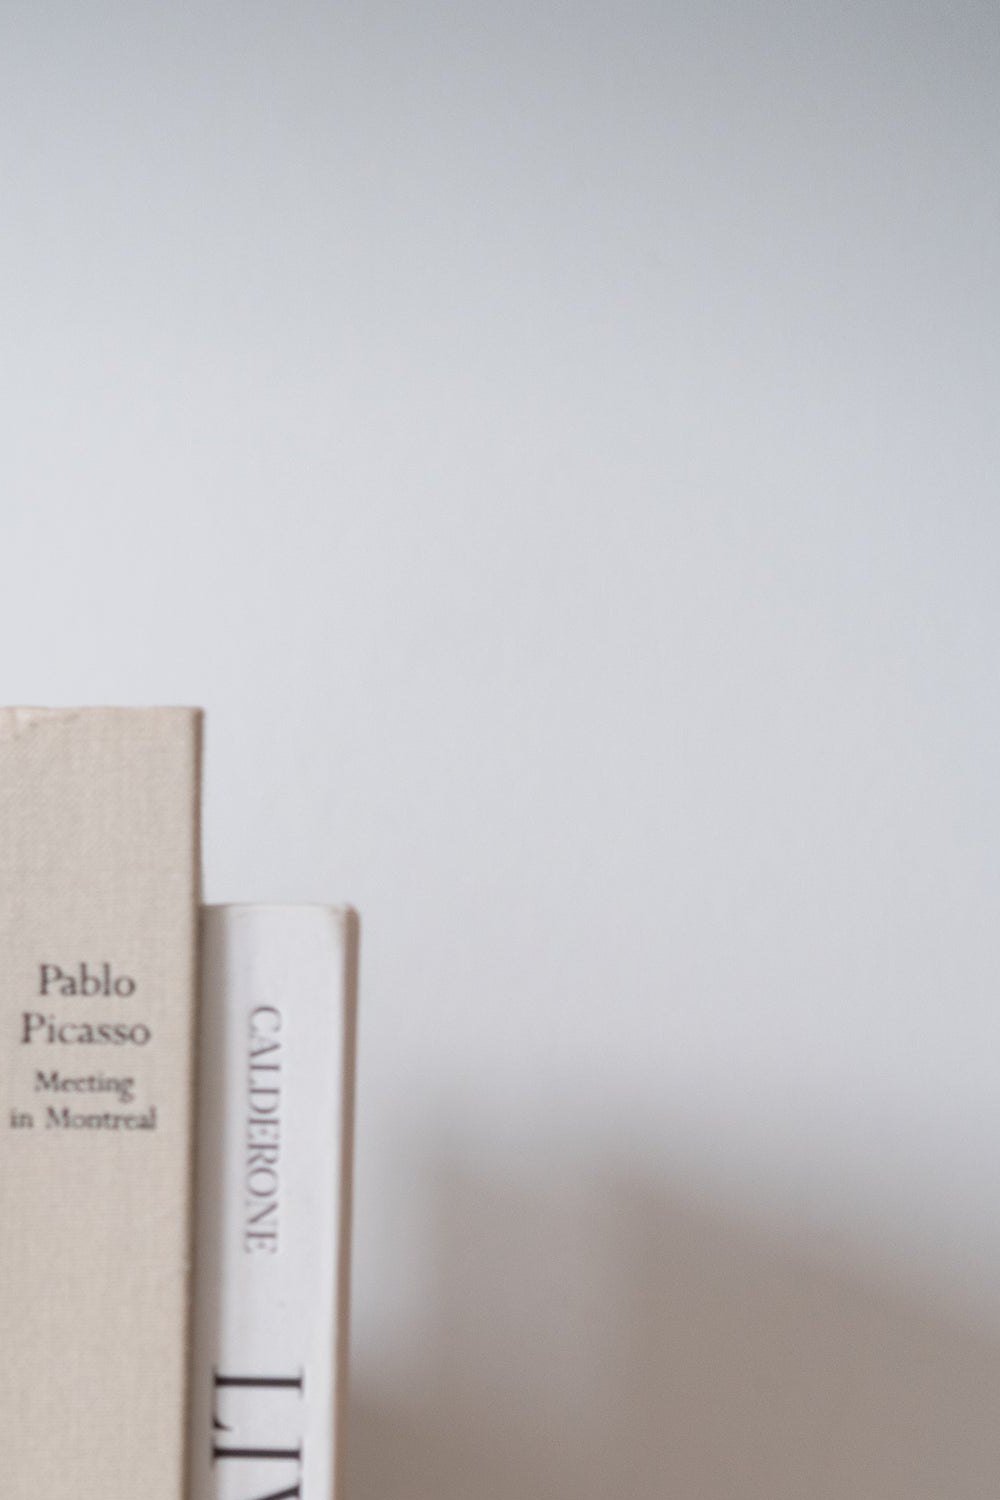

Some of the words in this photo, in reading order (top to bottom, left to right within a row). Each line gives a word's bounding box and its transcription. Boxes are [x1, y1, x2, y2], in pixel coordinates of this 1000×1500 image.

[39, 961, 136, 998] Pablo
[21, 1012, 151, 1046] Picasso
[34, 1070, 135, 1103] Meeting
[9, 1108, 34, 1130] in
[46, 1105, 157, 1131] Montreal
[245, 1005, 282, 1254] CALDERONE
